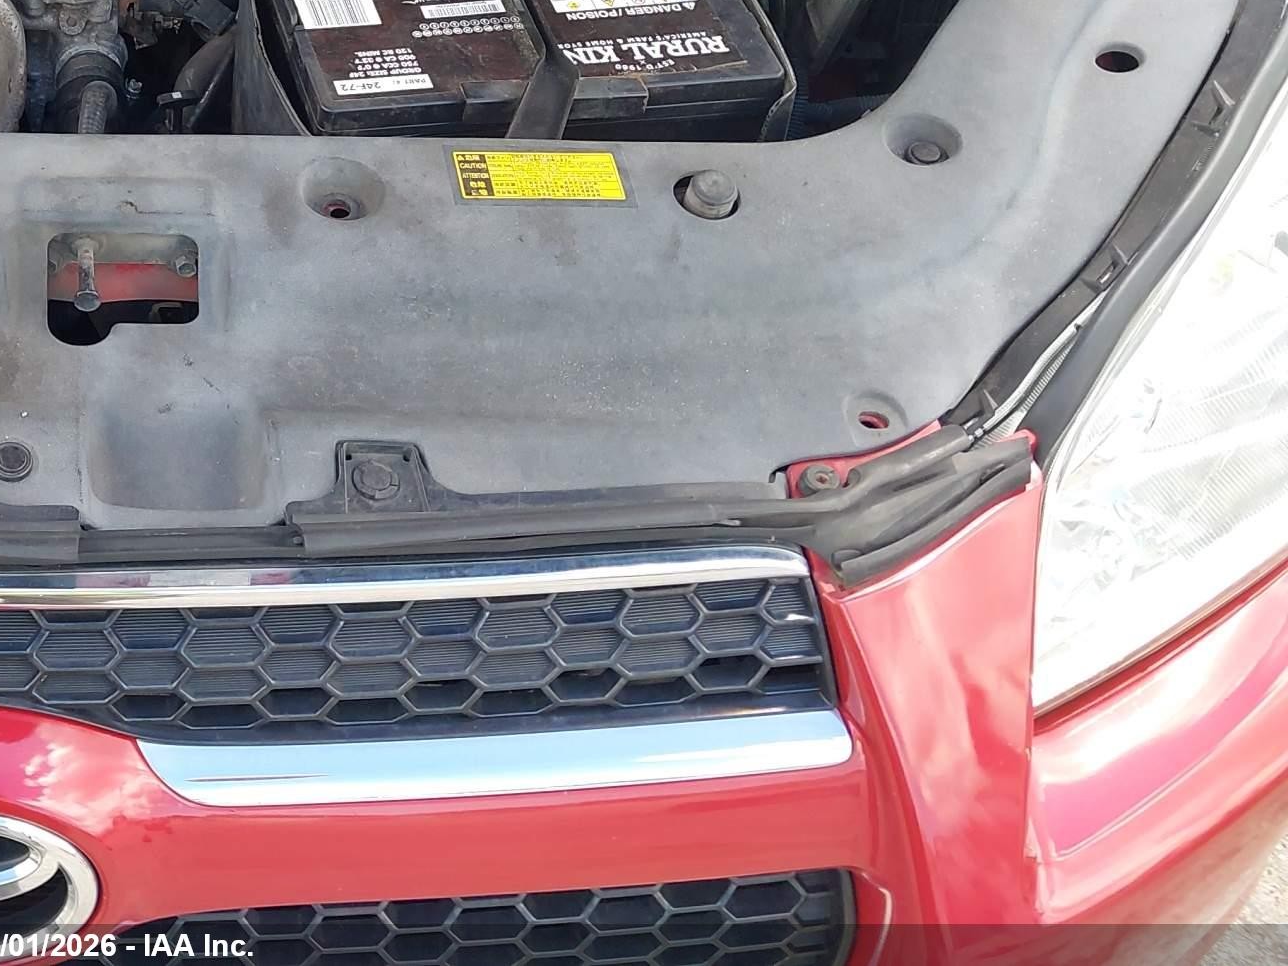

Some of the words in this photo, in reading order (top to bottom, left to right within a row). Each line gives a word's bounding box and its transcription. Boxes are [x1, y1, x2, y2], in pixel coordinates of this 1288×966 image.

[626, 2, 682, 16] DANGER
[627, 35, 653, 44] FARM
[654, 32, 707, 42] AMERICA'S
[557, 40, 584, 49] STOR
[585, 38, 613, 47] HOME
[621, 35, 731, 61] RURAL
[562, 44, 621, 65] KIN
[390, 67, 422, 75] GROUP
[340, 81, 381, 91] 24F-72
